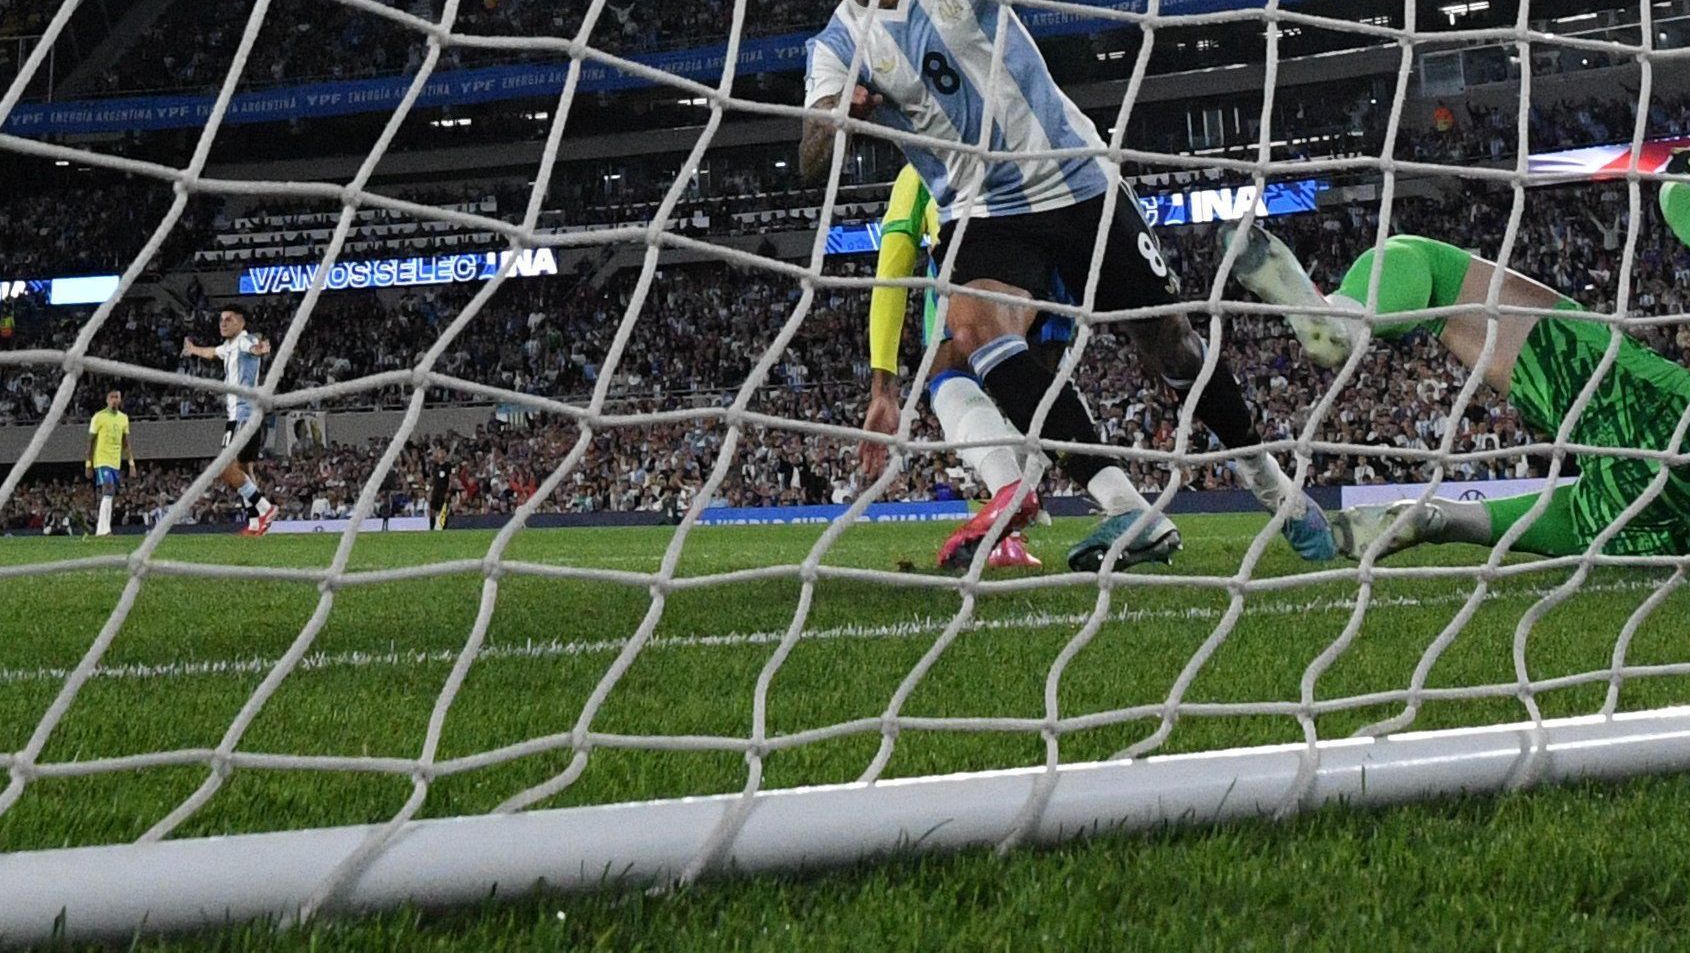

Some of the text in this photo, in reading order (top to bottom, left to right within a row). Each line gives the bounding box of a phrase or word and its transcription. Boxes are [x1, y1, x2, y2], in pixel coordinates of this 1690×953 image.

[10, 113, 44, 126] YPF
[157, 105, 190, 118] YPF
[306, 93, 342, 107] YPF
[394, 83, 451, 99] ARNTINA
[460, 79, 497, 95] YPF
[548, 68, 606, 85] ARGTINA
[706, 49, 763, 68] ARGTINA
[922, 51, 961, 96] 8
[1137, 231, 1167, 277] 8
